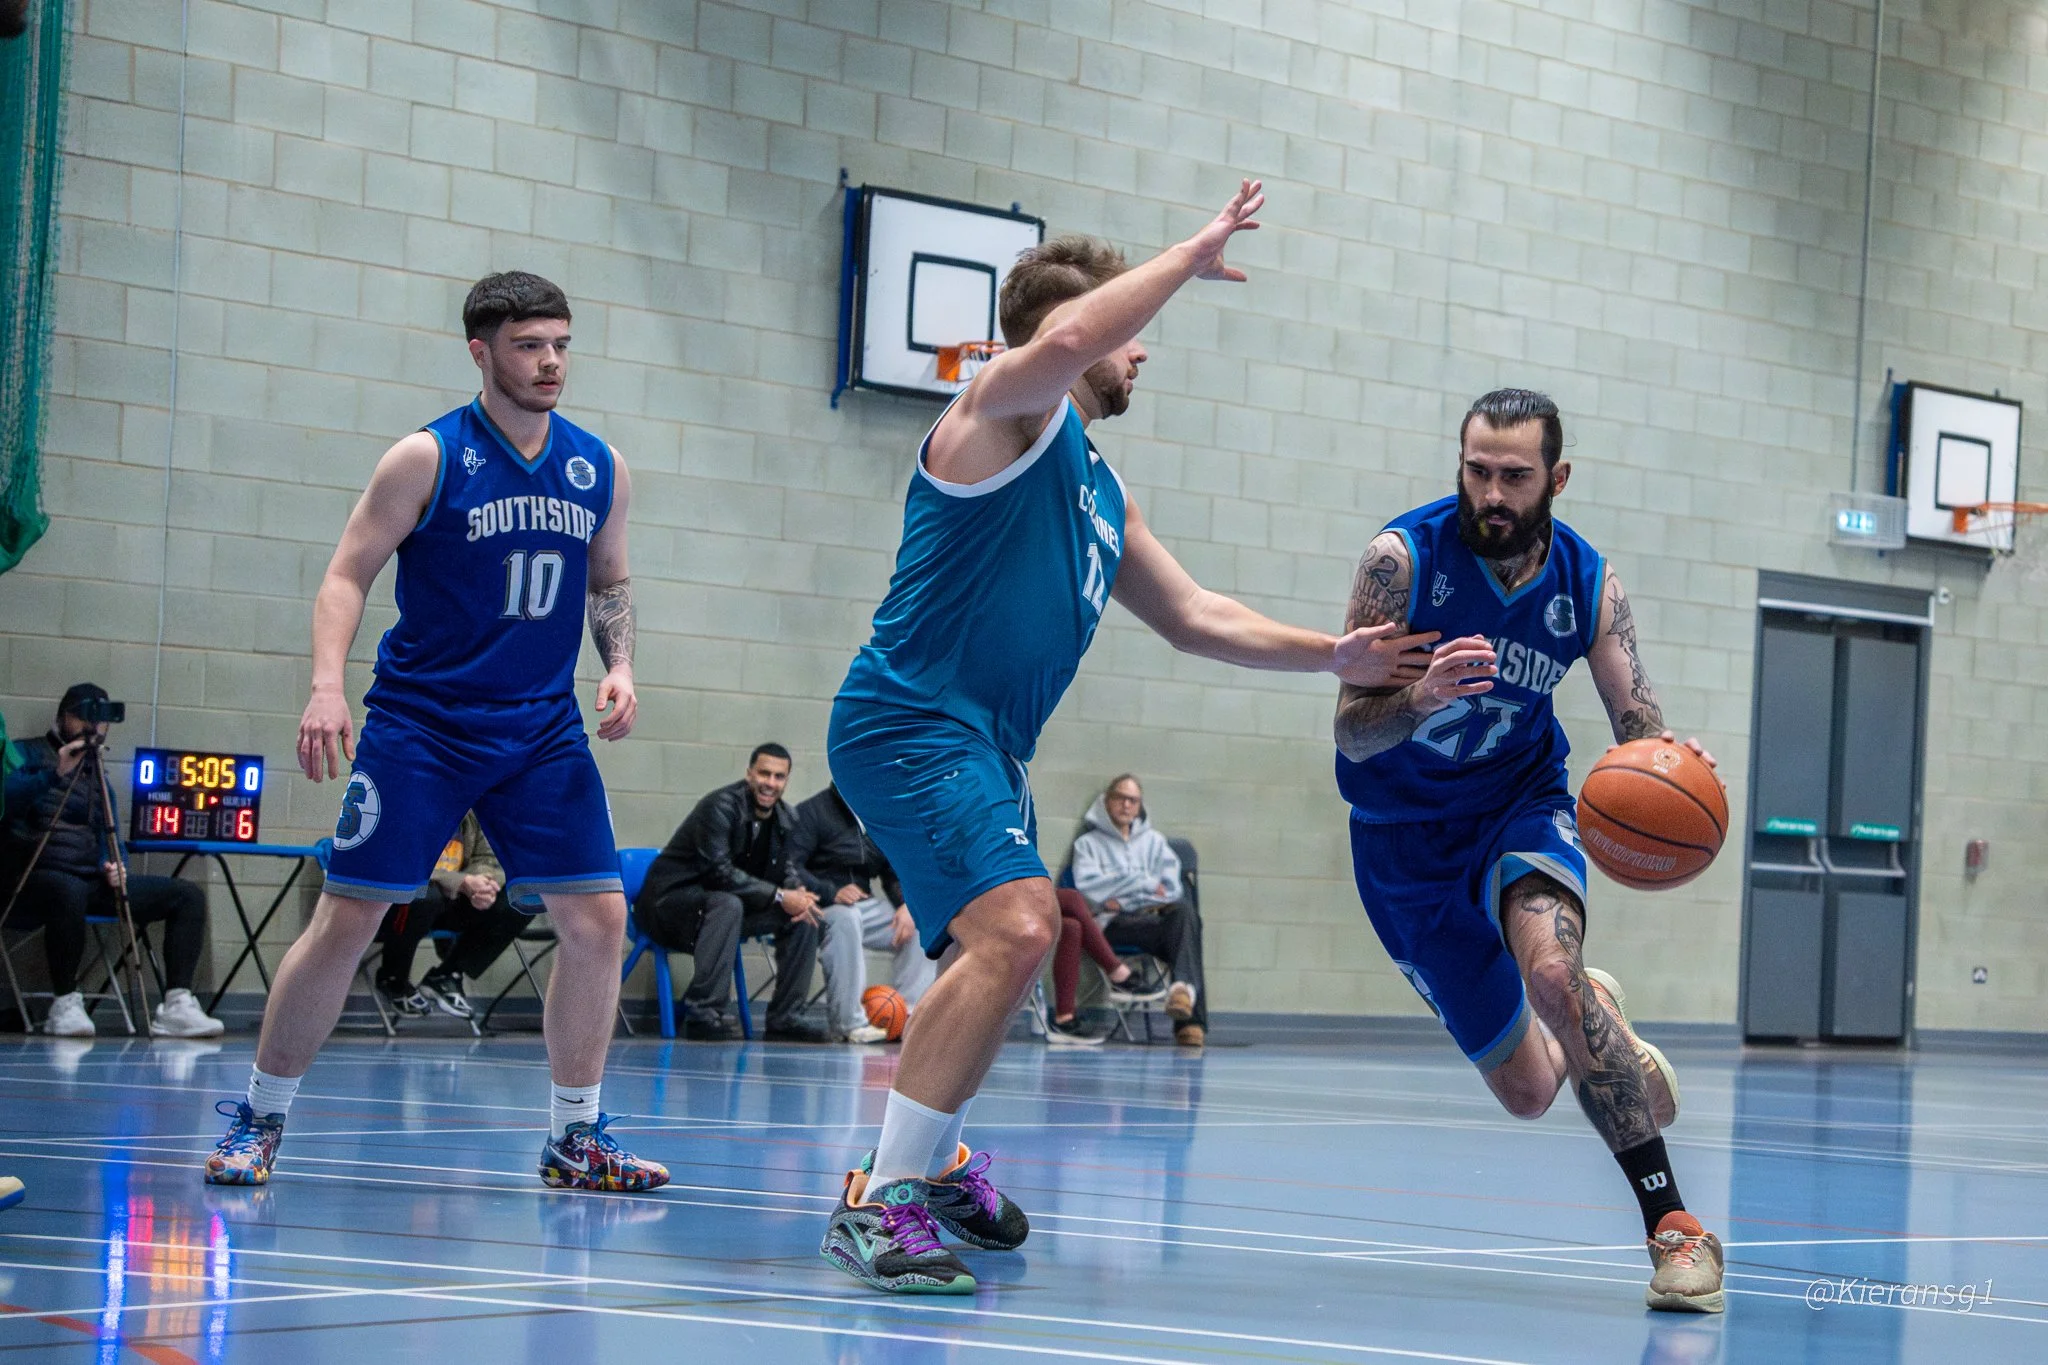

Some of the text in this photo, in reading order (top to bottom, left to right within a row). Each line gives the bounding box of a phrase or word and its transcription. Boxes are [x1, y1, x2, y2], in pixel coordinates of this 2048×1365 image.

[466, 495, 597, 543] SOUTHSIDE
[499, 549, 566, 621] 10
[1411, 696, 1528, 764] 27
[139, 755, 259, 791] 0 5:05 0
[154, 805, 253, 838] 14 6
